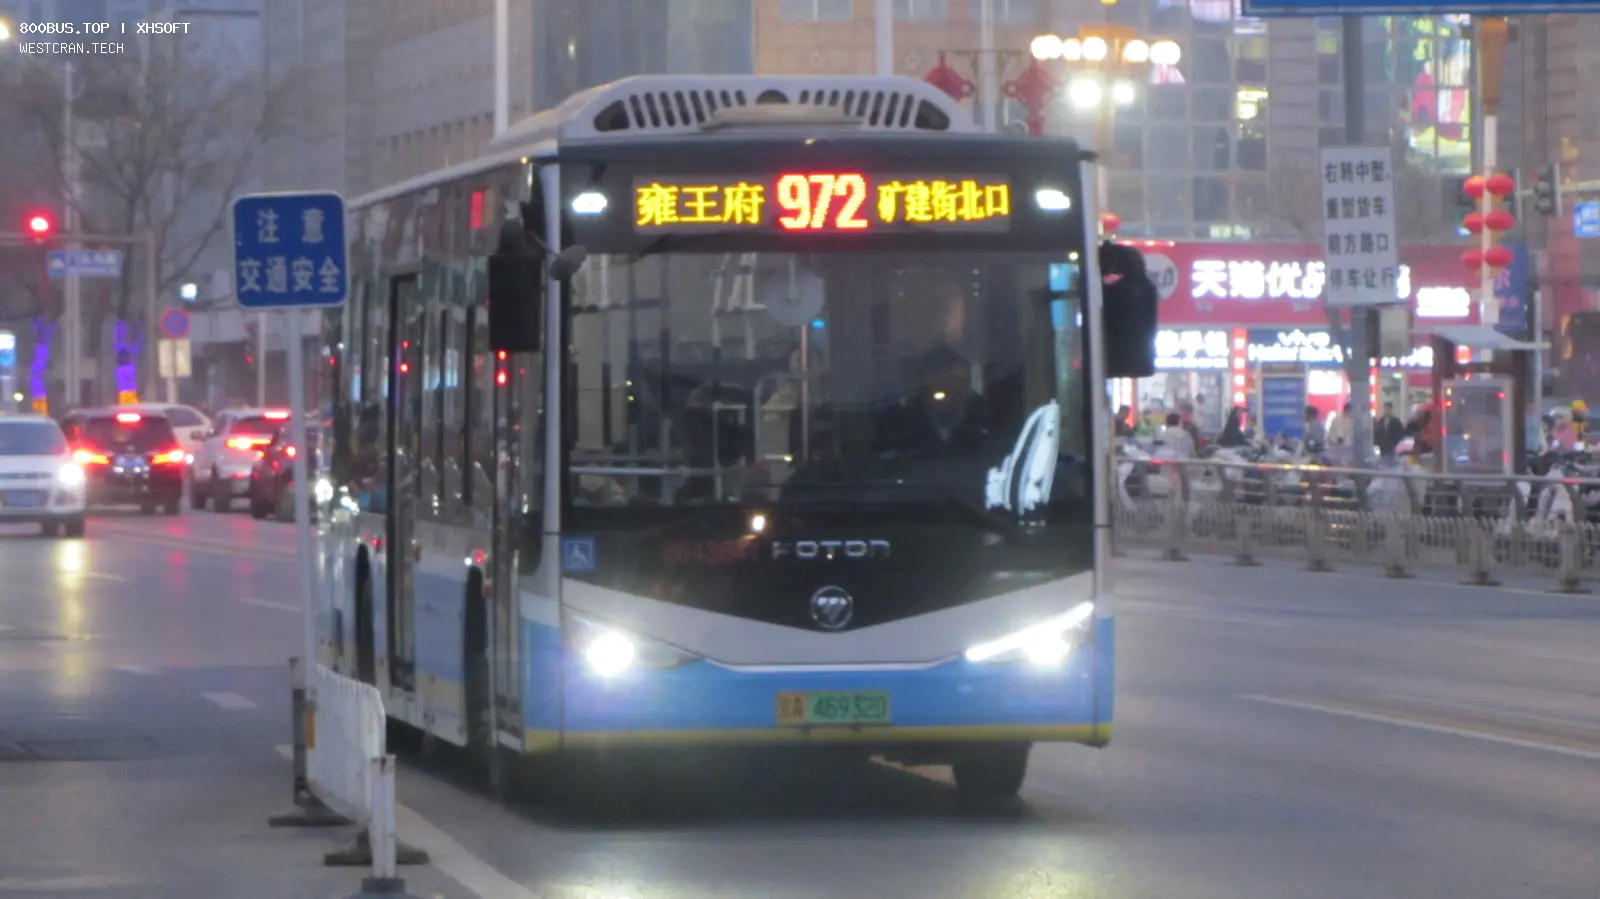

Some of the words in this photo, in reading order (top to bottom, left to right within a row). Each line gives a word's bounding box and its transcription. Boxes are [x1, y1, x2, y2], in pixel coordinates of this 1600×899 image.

[636, 182, 765, 226] 雍王府
[776, 173, 868, 230] 972
[877, 180, 1010, 223] 矿建街北口
[1326, 196, 1385, 219] 重型货车
[256, 207, 325, 243] 注意
[1328, 232, 1389, 255] 前方路口
[239, 256, 341, 294] 交通安全
[1330, 266, 1394, 291] 停车让行
[772, 539, 891, 560] FOTON
